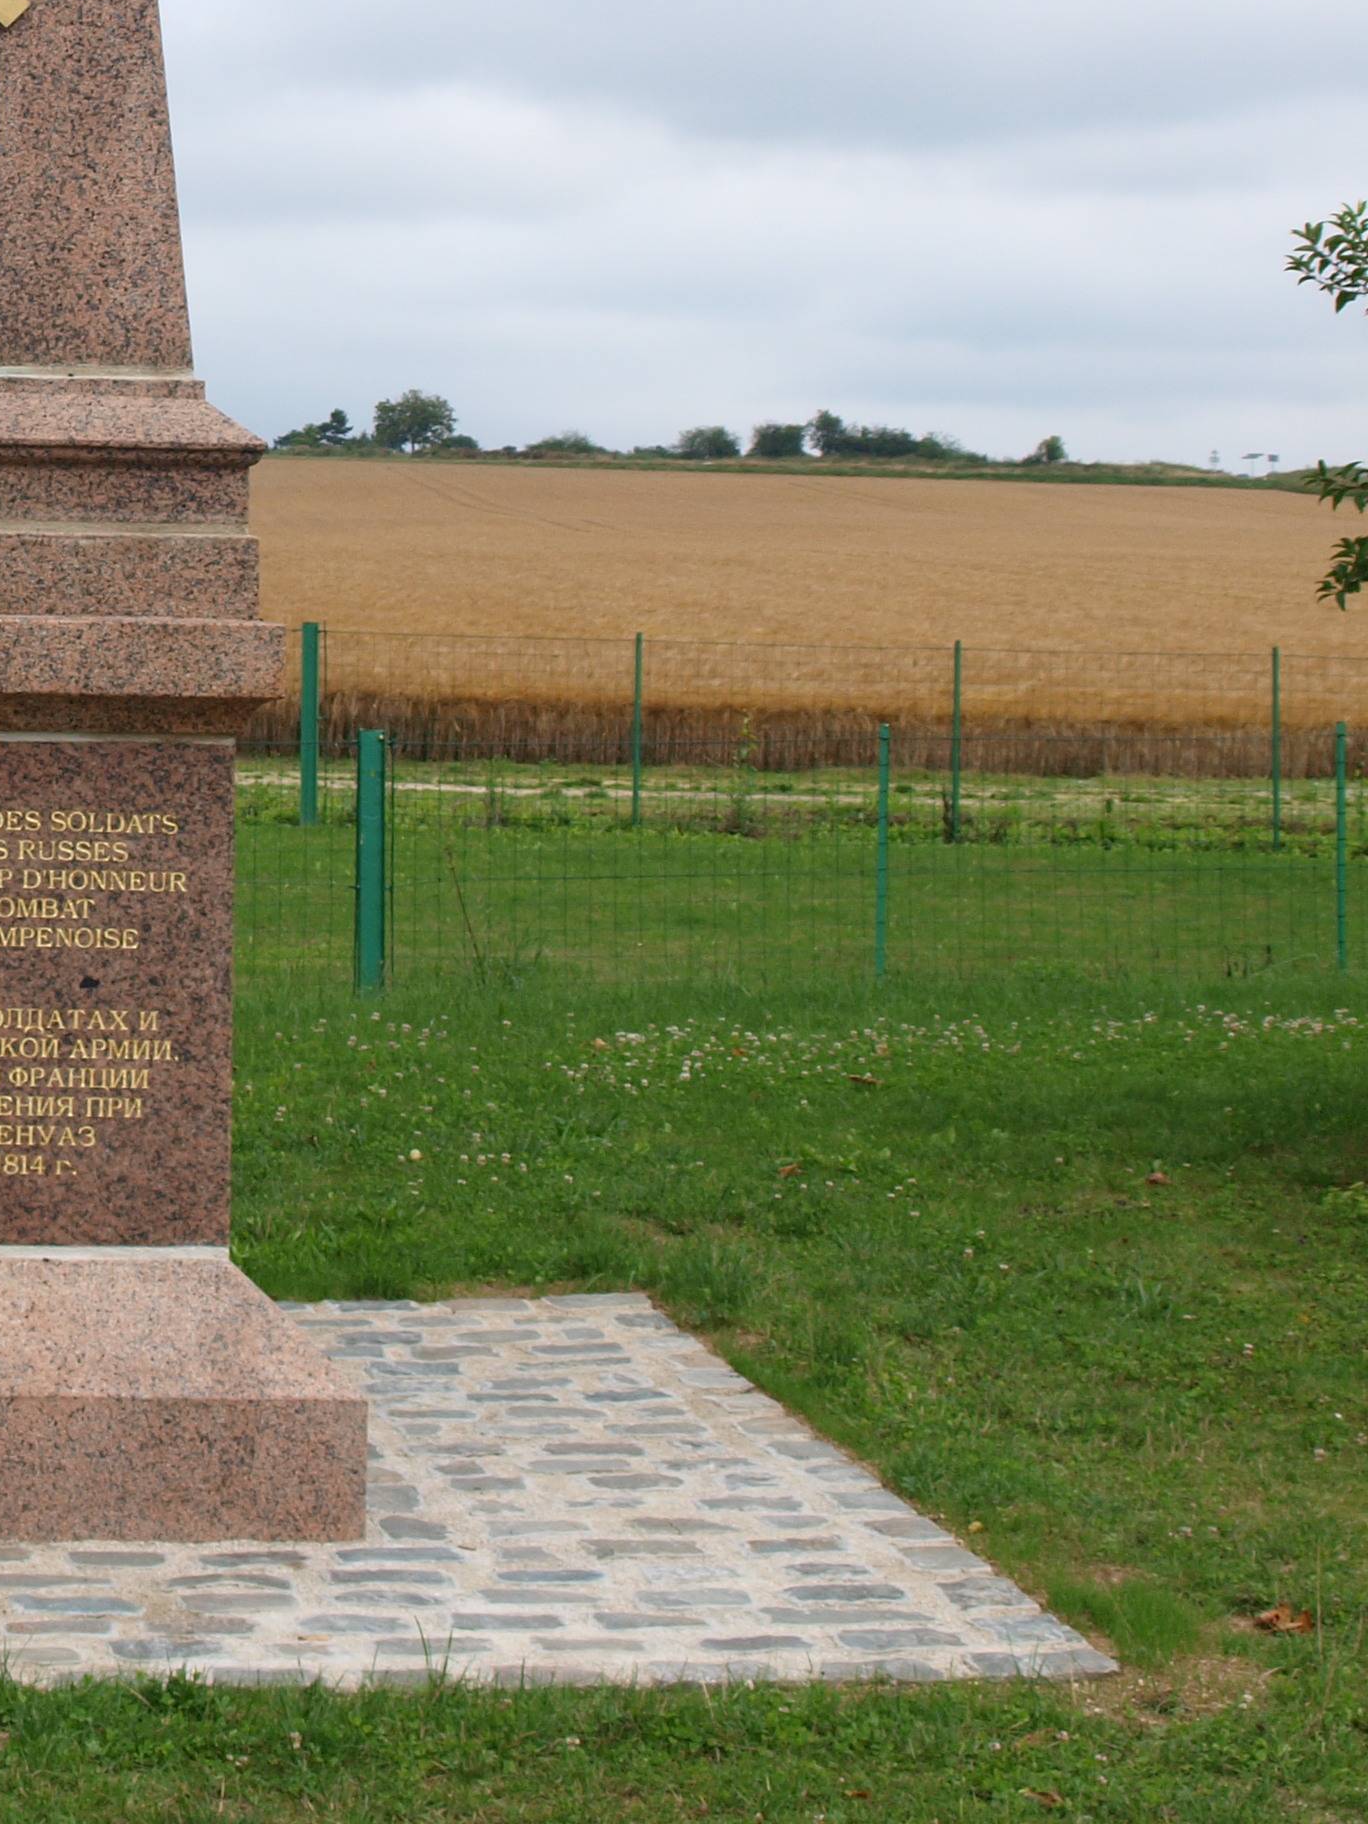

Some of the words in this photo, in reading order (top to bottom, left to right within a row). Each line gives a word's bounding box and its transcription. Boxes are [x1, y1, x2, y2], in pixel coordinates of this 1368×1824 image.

[51, 811, 179, 835] SOLDATS
[19, 841, 129, 863] RUSSES
[22, 870, 187, 892] D'HONNEUR
[139, 1011, 159, 1031] И
[8, 1066, 150, 1091] ФРАНЦИИ
[86, 1097, 143, 1118] ПРИ
